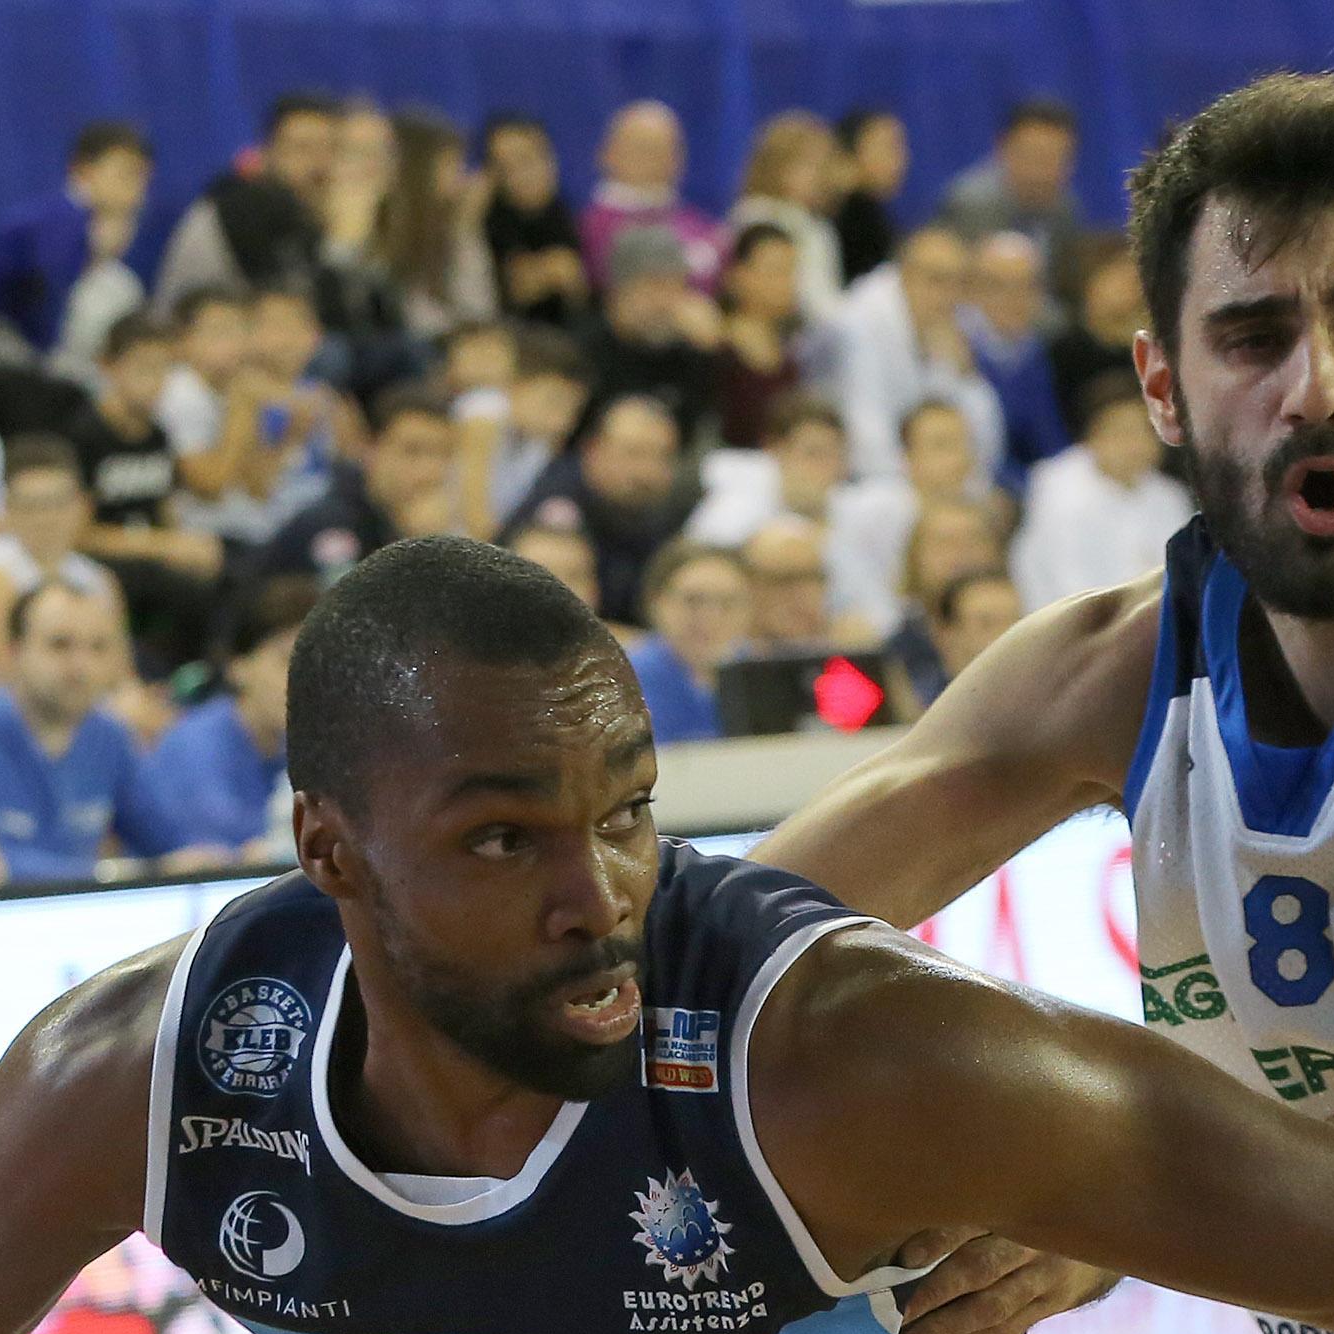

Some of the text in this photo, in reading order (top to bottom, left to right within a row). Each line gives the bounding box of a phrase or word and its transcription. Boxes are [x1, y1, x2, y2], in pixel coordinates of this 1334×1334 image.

[224, 985, 304, 1020] BASKET
[222, 1028, 292, 1051] KLEB
[622, 1281, 765, 1312] EUROTREND
[629, 1302, 768, 1332] Assistenza
